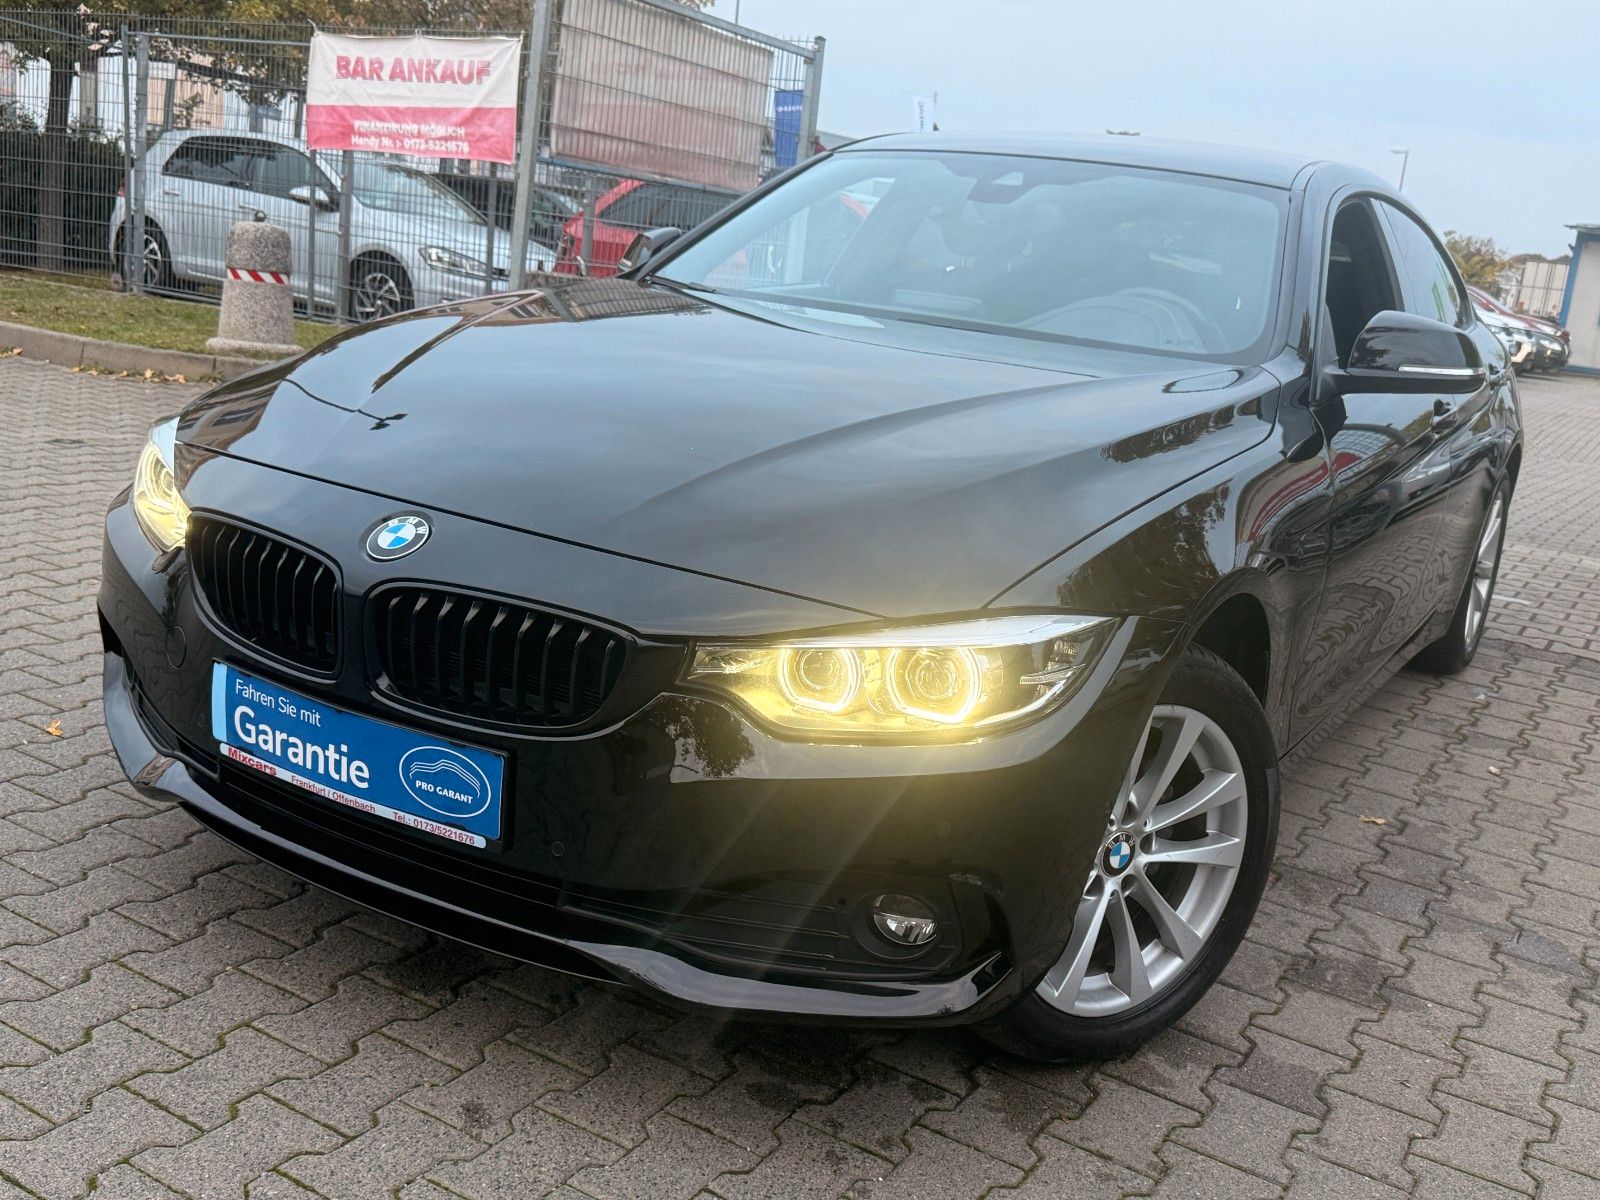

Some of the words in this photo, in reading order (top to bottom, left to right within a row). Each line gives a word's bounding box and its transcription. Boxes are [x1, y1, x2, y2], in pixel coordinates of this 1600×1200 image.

[336, 55, 385, 82] BAR
[389, 57, 491, 85] ANKAUF
[420, 122, 465, 138] MÖGLICH
[351, 135, 379, 150] Handy
[388, 516, 428, 534] BMW
[235, 679, 275, 709] Fahren
[278, 697, 297, 718] Sie
[300, 709, 321, 727] mit
[234, 705, 370, 789] Garantie
[228, 746, 278, 776] Mixcars
[291, 775, 326, 797] Frankfurt
[332, 791, 376, 814] Offenbach
[392, 811, 411, 825] Tel.:
[413, 818, 476, 845] 0173/5221676
[415, 780, 435, 793] PRO
[436, 786, 474, 804] GARANT
[1107, 834, 1136, 850] BMW
